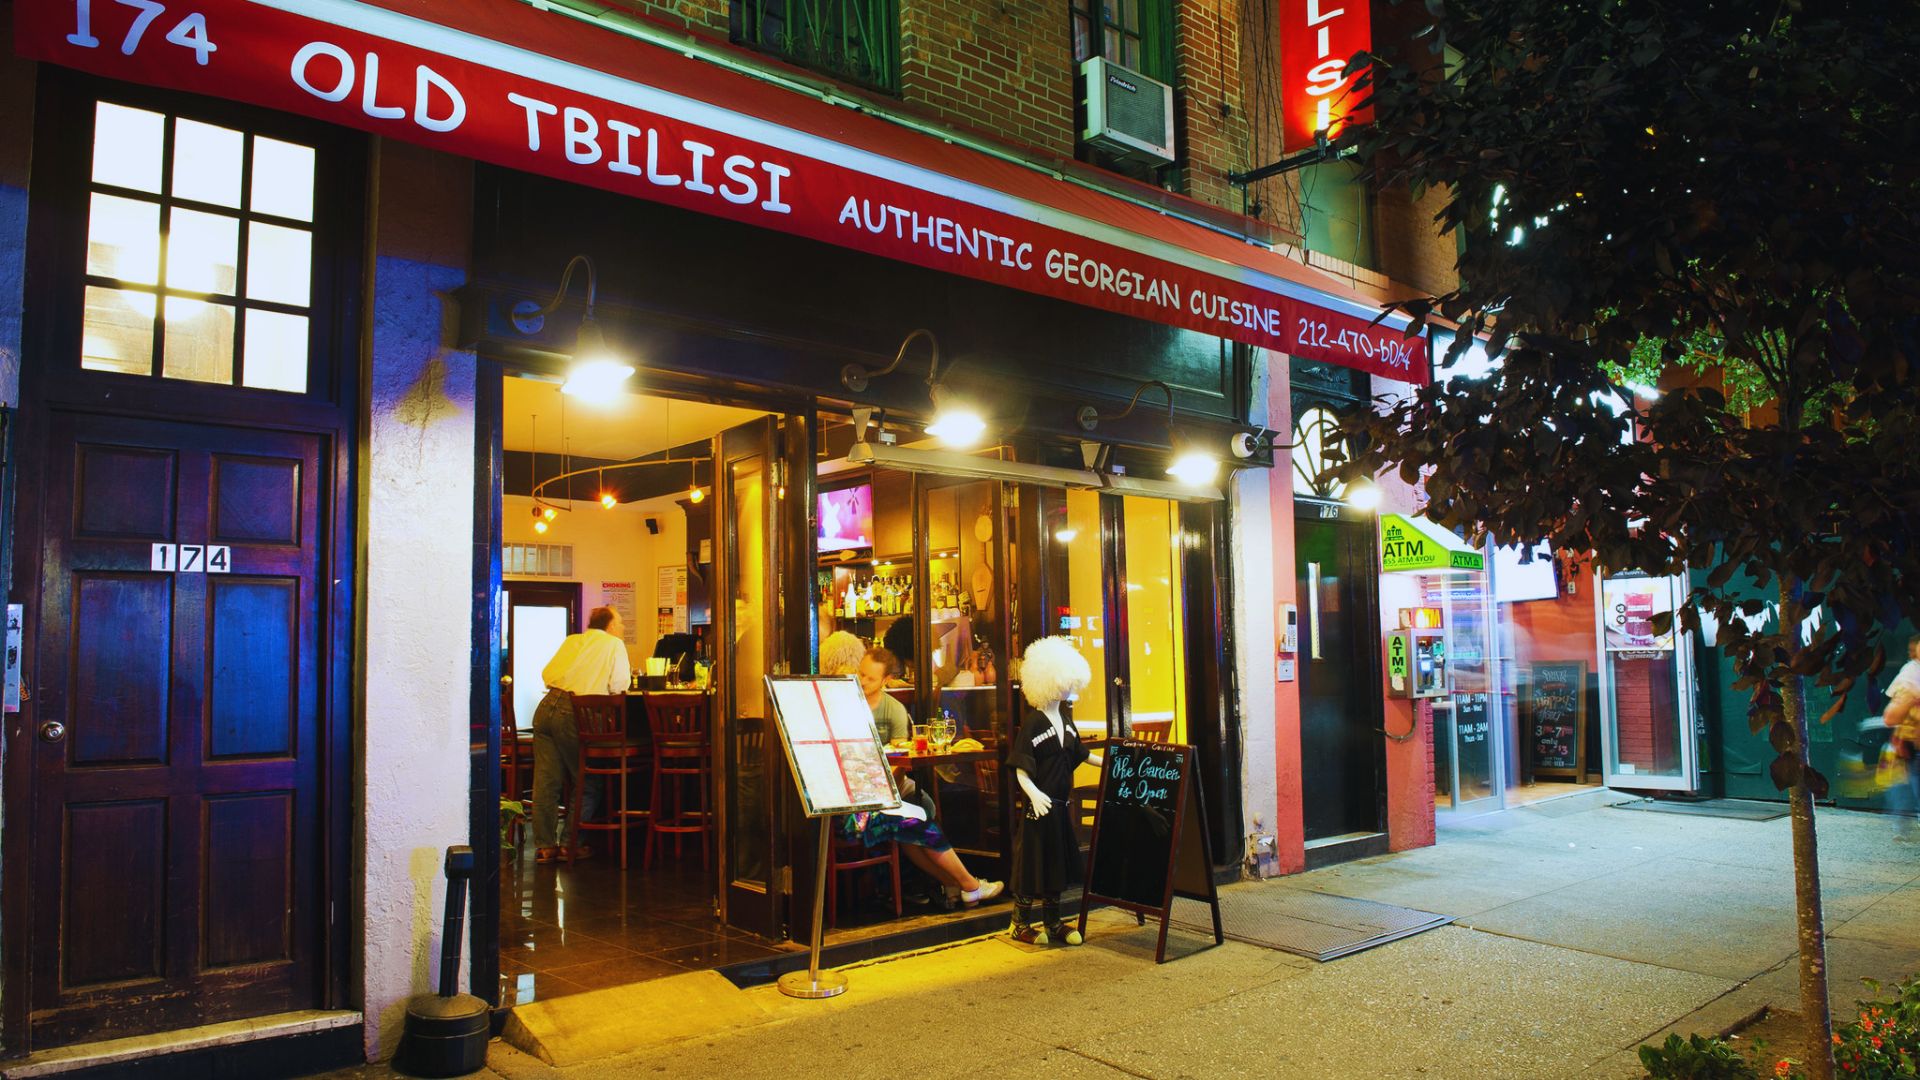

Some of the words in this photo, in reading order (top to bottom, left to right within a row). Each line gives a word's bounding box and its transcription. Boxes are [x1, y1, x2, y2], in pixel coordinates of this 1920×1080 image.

[67, 0, 218, 66] 174
[291, 42, 467, 133] OLD
[508, 92, 792, 214] TBILISI
[839, 195, 1033, 271] AUTHENTIC
[1045, 249, 1181, 310] GEORGIAN
[1189, 289, 1281, 337] CUISINE
[1298, 318, 1413, 371] 212-470-6064
[161, 546, 226, 570] 174
[1384, 540, 1423, 558] ATM
[1452, 555, 1473, 566] ATM
[1392, 636, 1404, 666] ATM
[1112, 755, 1135, 779] The
[1138, 757, 1180, 780] Garden
[1135, 780, 1168, 804] Open
